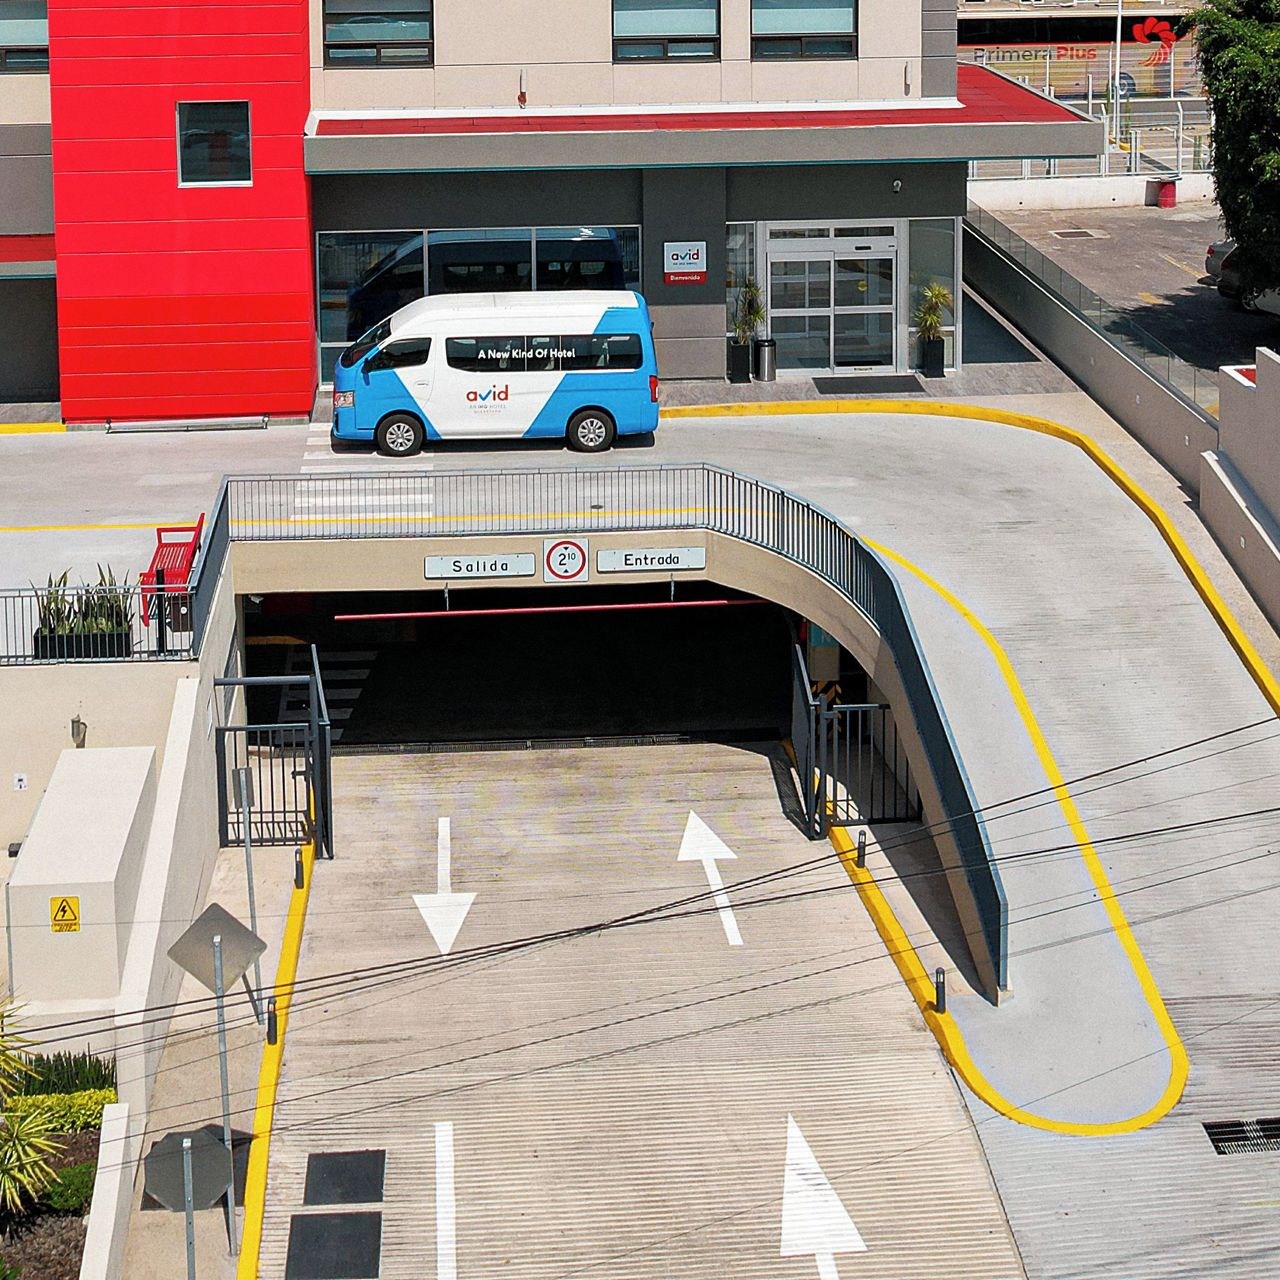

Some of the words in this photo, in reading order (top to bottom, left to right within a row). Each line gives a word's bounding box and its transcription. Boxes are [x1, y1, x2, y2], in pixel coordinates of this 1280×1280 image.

[973, 46, 1053, 62] Primera
[1056, 45, 1097, 61] Plus
[671, 248, 700, 261] avid
[477, 349, 486, 360] A
[487, 349, 511, 360] New
[511, 347, 534, 359] Kind
[535, 347, 548, 359] Of
[549, 347, 576, 359] Hotel
[466, 384, 509, 402] avid
[452, 559, 509, 573] Salida
[624, 553, 680, 567] Entrada
